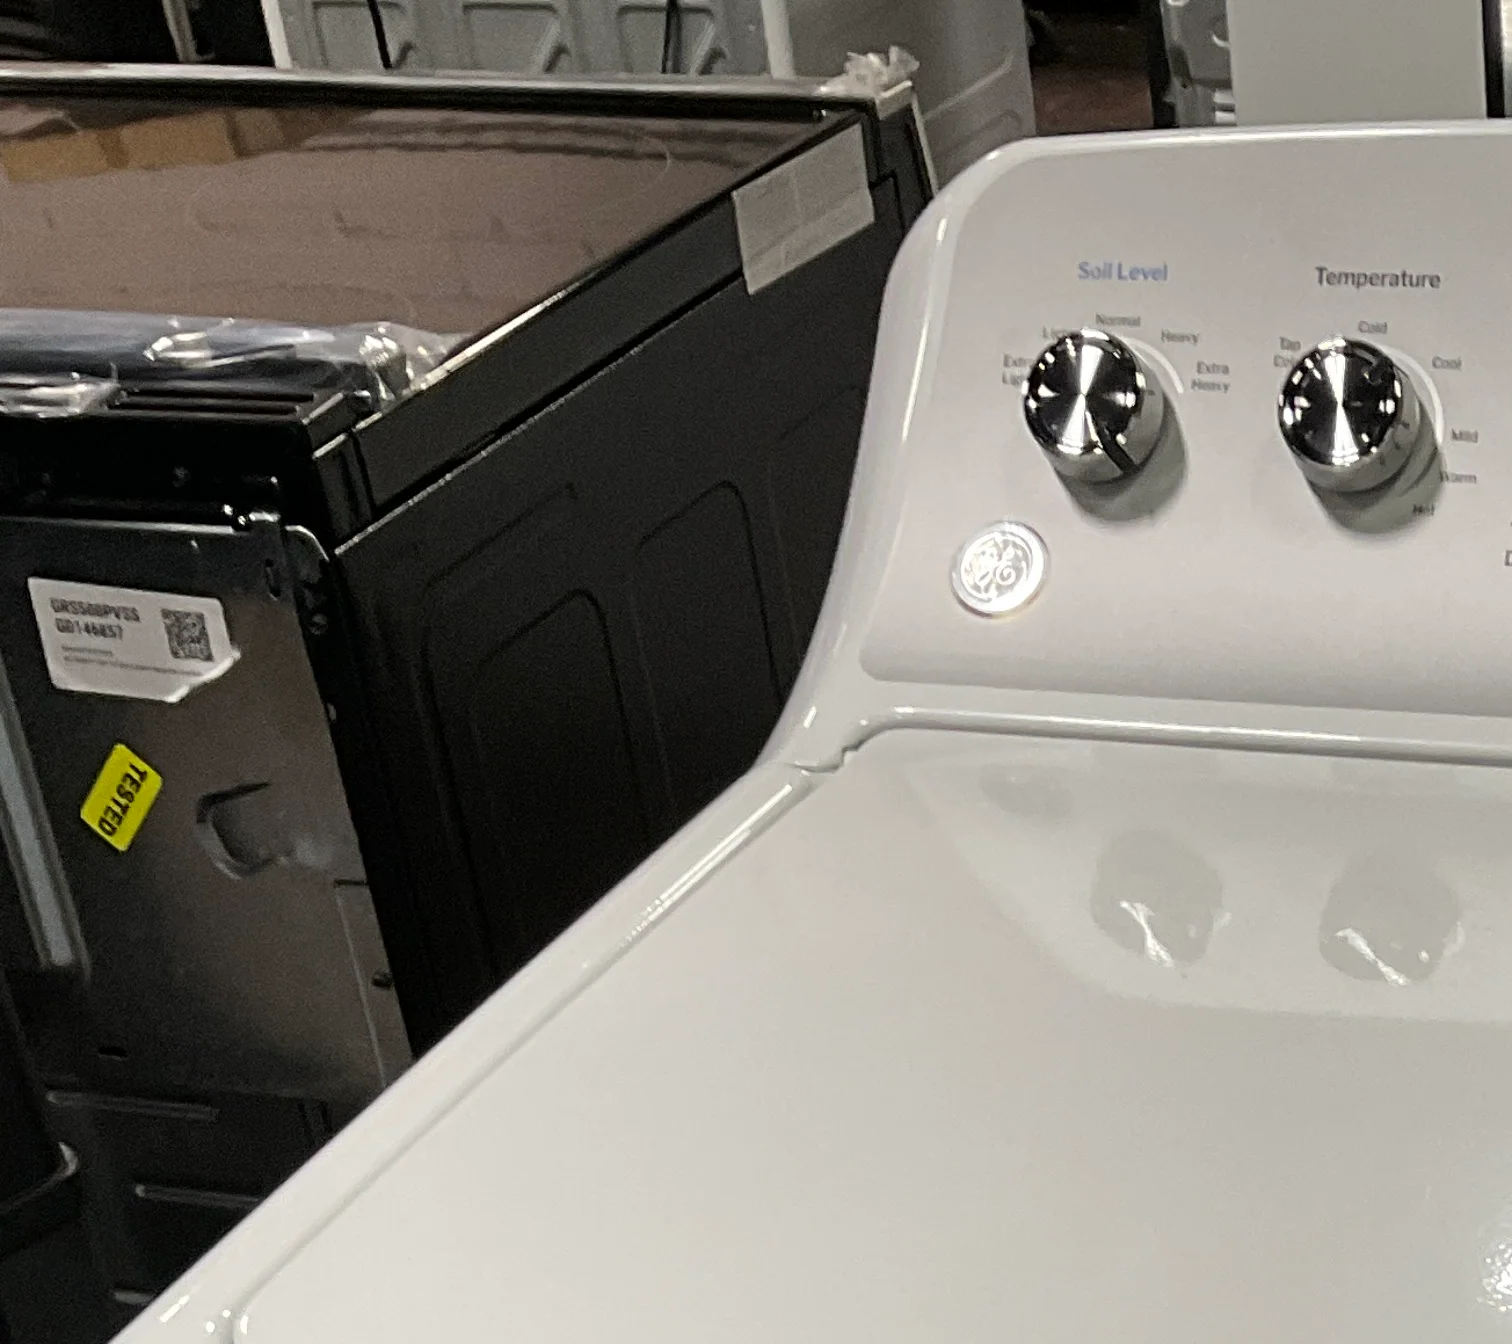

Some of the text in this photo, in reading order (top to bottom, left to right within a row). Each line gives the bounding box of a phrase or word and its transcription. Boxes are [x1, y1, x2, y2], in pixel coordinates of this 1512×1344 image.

[1077, 261, 1169, 282] Soil Level
[1315, 266, 1442, 290] Temperature
[1196, 360, 1230, 376] Extra
[97, 761, 149, 837] TESTED
